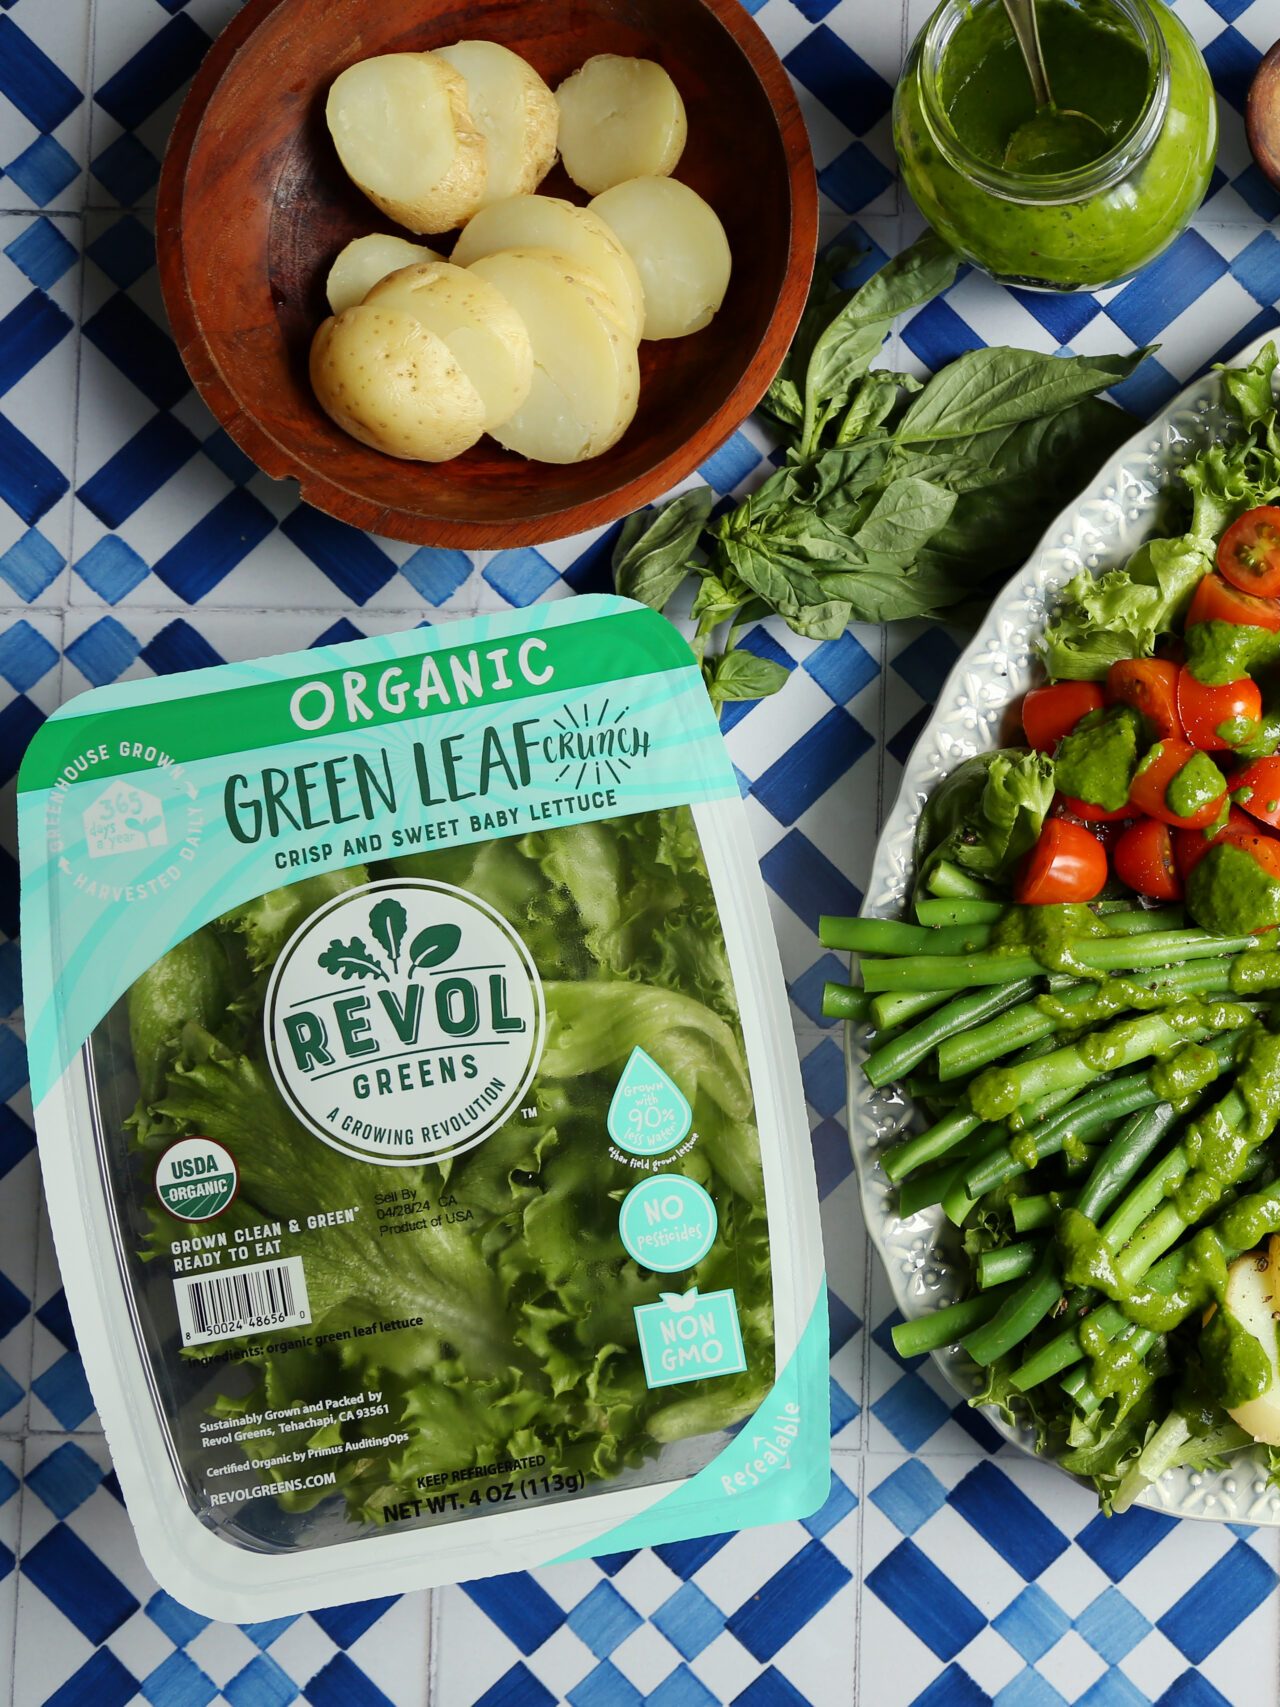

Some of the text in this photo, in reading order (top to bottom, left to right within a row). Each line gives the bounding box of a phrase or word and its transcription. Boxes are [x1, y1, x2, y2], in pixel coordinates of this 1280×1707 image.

[290, 637, 555, 731] ORGANIC
[46, 741, 186, 853] GREENHOUSE GROWN
[223, 747, 397, 843] GREEN
[412, 718, 540, 806] LEAF
[99, 791, 142, 820] 365
[274, 789, 617, 869] CRISP AND SWEET BABY LETTUCE
[73, 807, 203, 902] HARVESTED DAILY
[283, 974, 526, 1073] REVOL
[353, 1054, 478, 1099] GREENS
[326, 1077, 506, 1145] A GROWING REVOLUTION
[628, 1106, 674, 1131] 90%
[624, 1127, 644, 1146] less
[630, 1158, 649, 1170] field
[652, 1155, 677, 1172] grown
[675, 1132, 699, 1157] lettuce
[171, 1154, 219, 1179] USDA
[169, 1178, 228, 1202] ORGANIC
[374, 1188, 417, 1205] Sell By
[376, 1194, 458, 1220] 04/28/24 CA
[380, 1209, 474, 1237] Product of USA
[643, 1195, 684, 1226] NO
[171, 1232, 228, 1255] GROWN
[234, 1222, 282, 1243] CLEAN
[288, 1219, 301, 1233] &
[636, 1223, 702, 1250] pesticides
[173, 1240, 282, 1272] READY TO EAT
[185, 1311, 306, 1340] 8 50024 48656 0
[187, 1316, 424, 1369] Ingredients: organic green leaf lettuce
[660, 1312, 716, 1345] NON
[661, 1339, 723, 1371] GMO
[199, 1390, 383, 1434] Sustainably Grown and Packed by
[202, 1404, 390, 1448] Revol Greens, Tehachapi, CA 93561
[206, 1432, 409, 1478] Certified Organic by Primus AuditingOps
[720, 1402, 801, 1496] Resealable
[416, 1454, 546, 1489] KEEP REFRIGERATED
[210, 1472, 336, 1507] REVOLGREENS.COM
[383, 1470, 585, 1523] NET WT. 4 OZ (113g)
